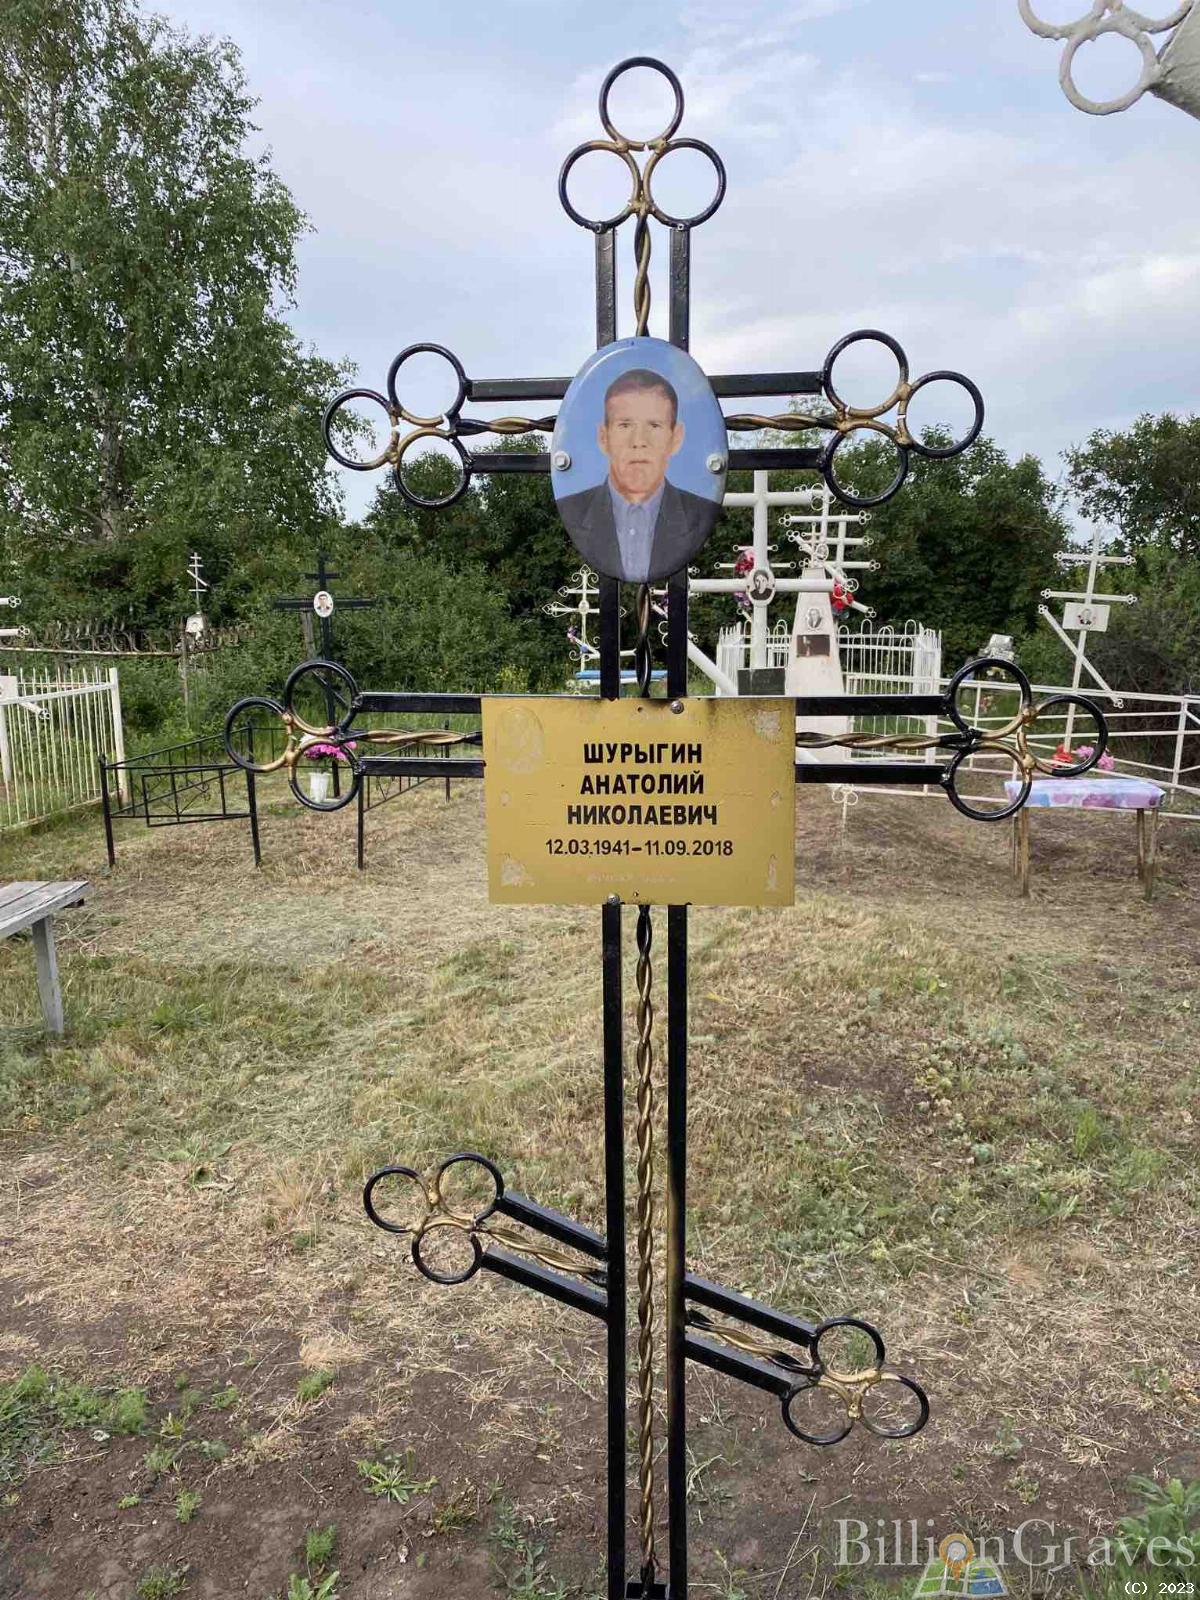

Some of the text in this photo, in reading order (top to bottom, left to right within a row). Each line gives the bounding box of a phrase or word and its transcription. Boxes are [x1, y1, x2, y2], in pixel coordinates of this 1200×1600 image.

[583, 743, 703, 764] ШУРЫГИН
[580, 770, 704, 795] АНАТОЛИЙ
[567, 804, 718, 826] НИКОЛАЕВИЧ
